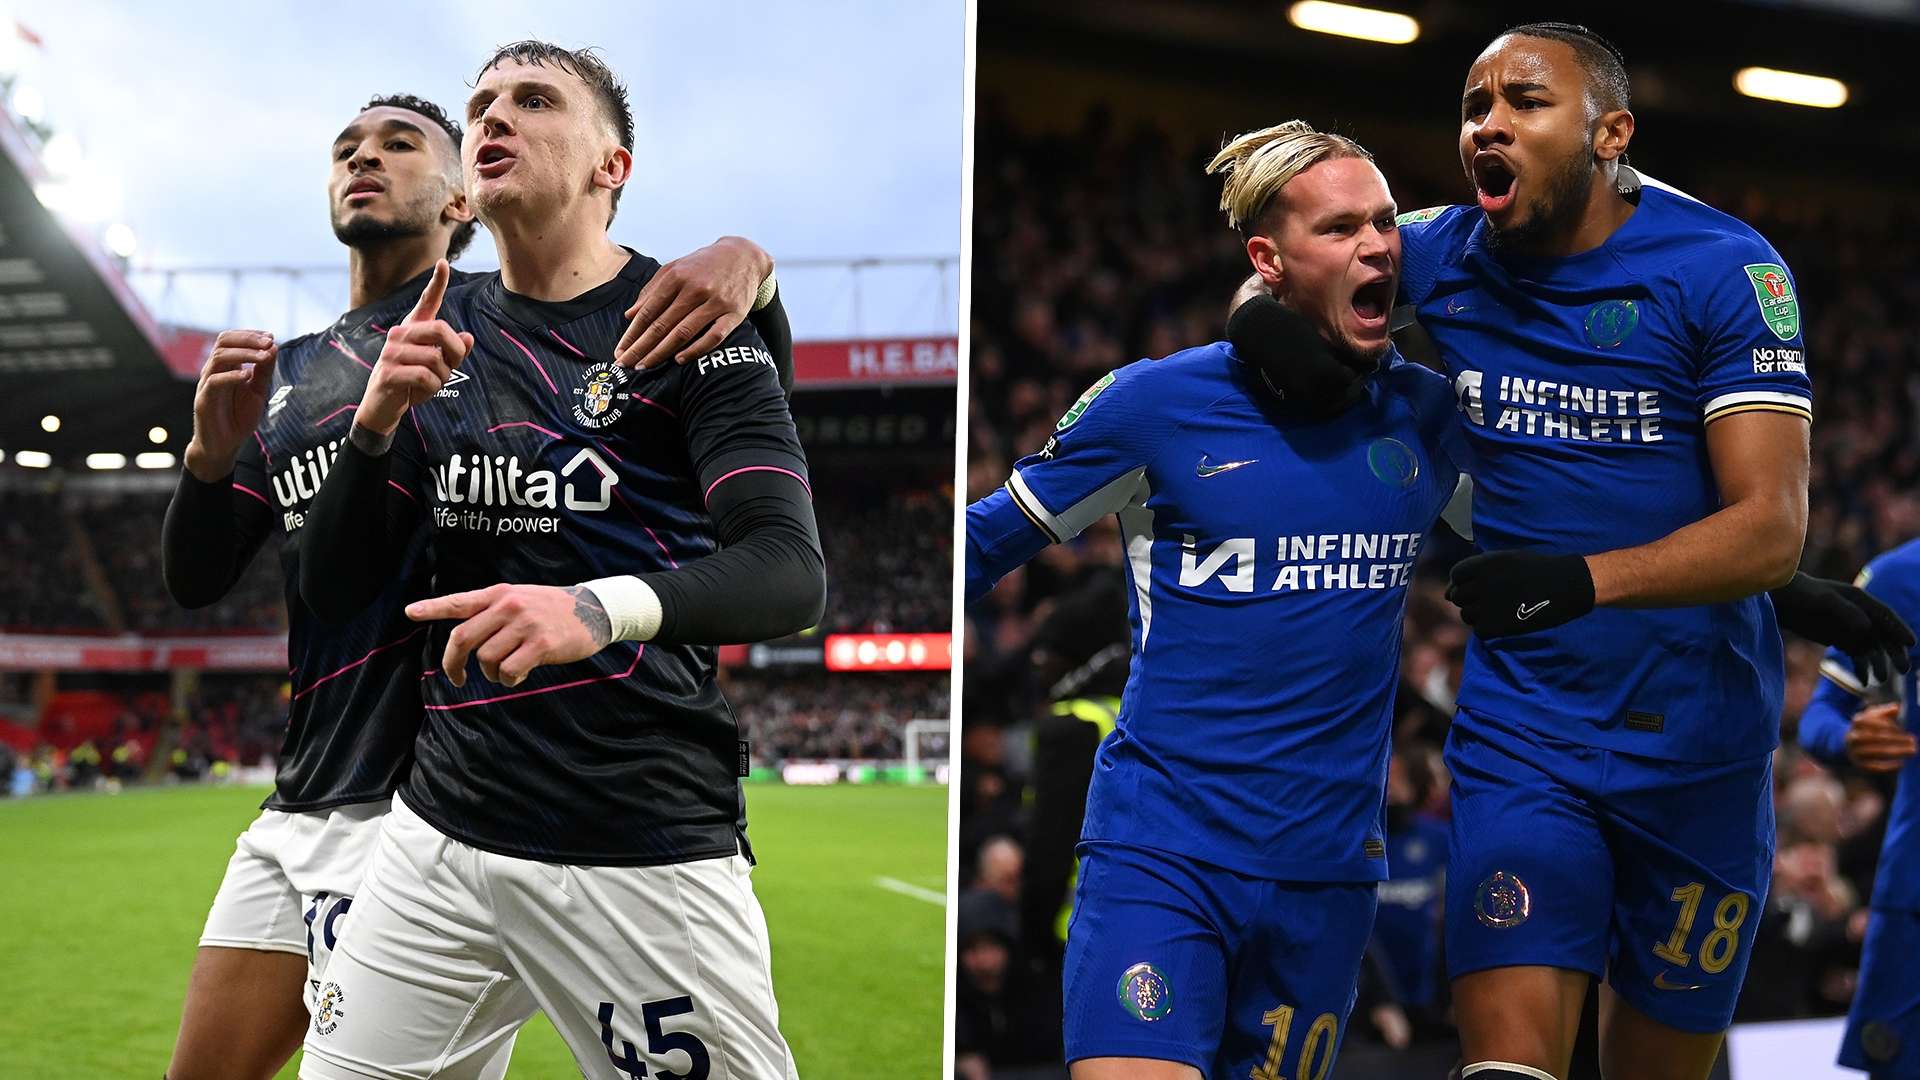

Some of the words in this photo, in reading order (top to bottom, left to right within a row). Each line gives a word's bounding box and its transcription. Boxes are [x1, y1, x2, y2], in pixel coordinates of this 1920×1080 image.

[1763, 294, 1793, 307] Carabao
[1774, 306, 1789, 316] Cup
[698, 346, 778, 375] FREENO
[1753, 347, 1775, 361] No
[1777, 349, 1801, 362] room
[581, 362, 608, 381] LUTON
[609, 363, 628, 384] TOWN
[433, 387, 460, 398] mbro
[1499, 375, 1661, 416] INFINITE
[572, 404, 601, 428] FOOTBALL
[602, 408, 622, 427] CLUB
[1495, 406, 1664, 443] ATHLETE
[430, 453, 557, 509] utilita
[283, 510, 304, 532] life
[434, 507, 458, 528] life
[460, 511, 491, 531] ith
[496, 516, 561, 536] power
[1277, 533, 1423, 561] INFINITE
[1271, 561, 1414, 591] ATHLETE
[1652, 881, 1750, 974] 18
[598, 995, 711, 1080] 45
[1248, 1004, 1338, 1080] 10
